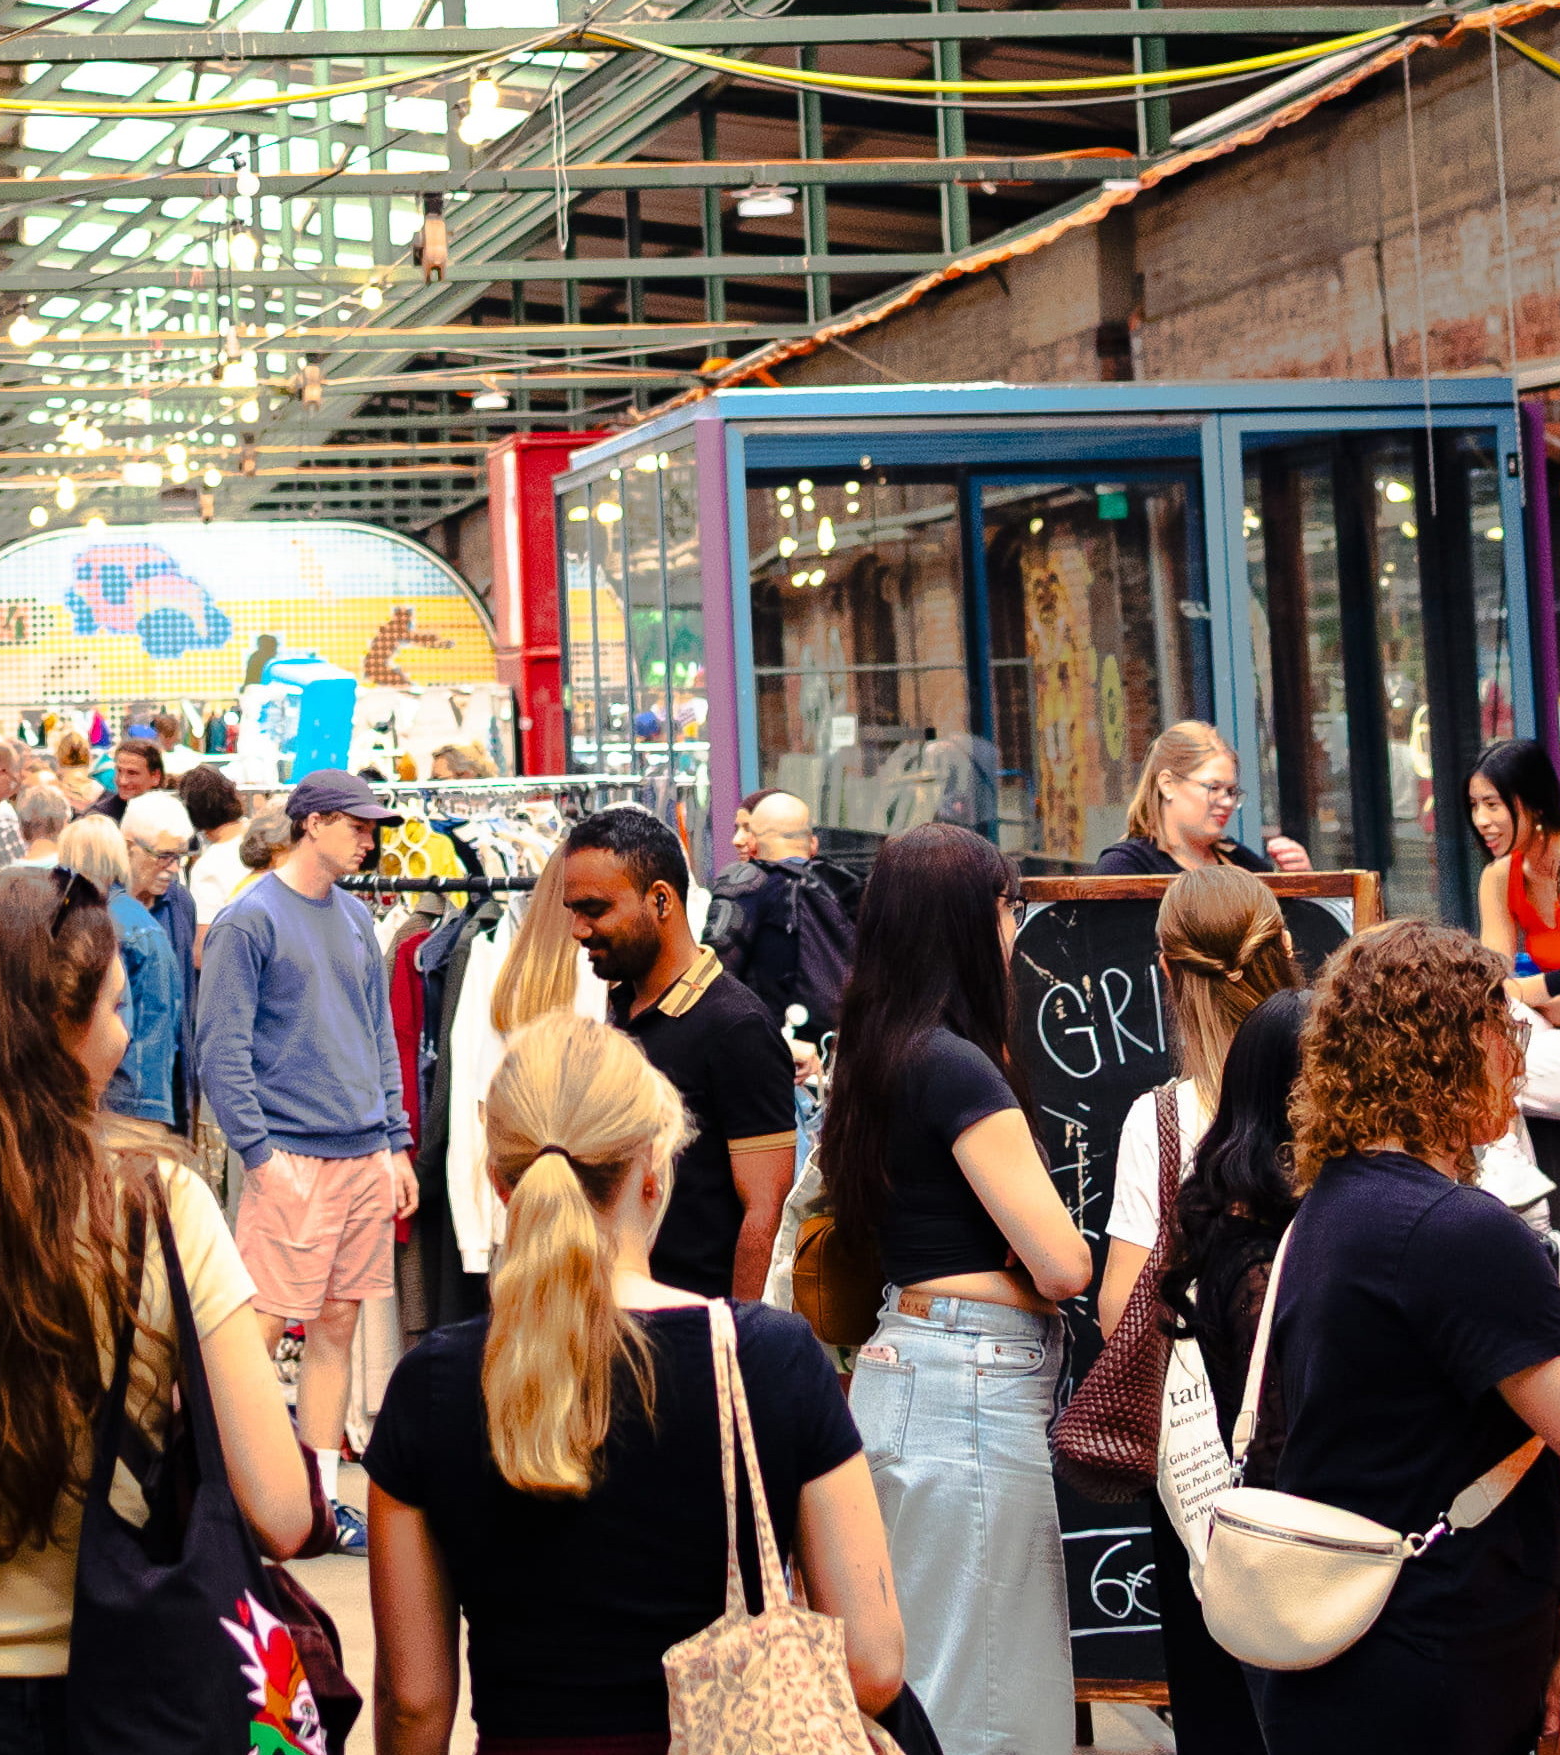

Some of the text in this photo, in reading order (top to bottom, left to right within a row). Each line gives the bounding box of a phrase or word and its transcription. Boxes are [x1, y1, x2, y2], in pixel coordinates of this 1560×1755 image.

[1037, 964, 1166, 1079] GRI
[1184, 1510, 1198, 1524] der
[1091, 1539, 1161, 1619] 6€
